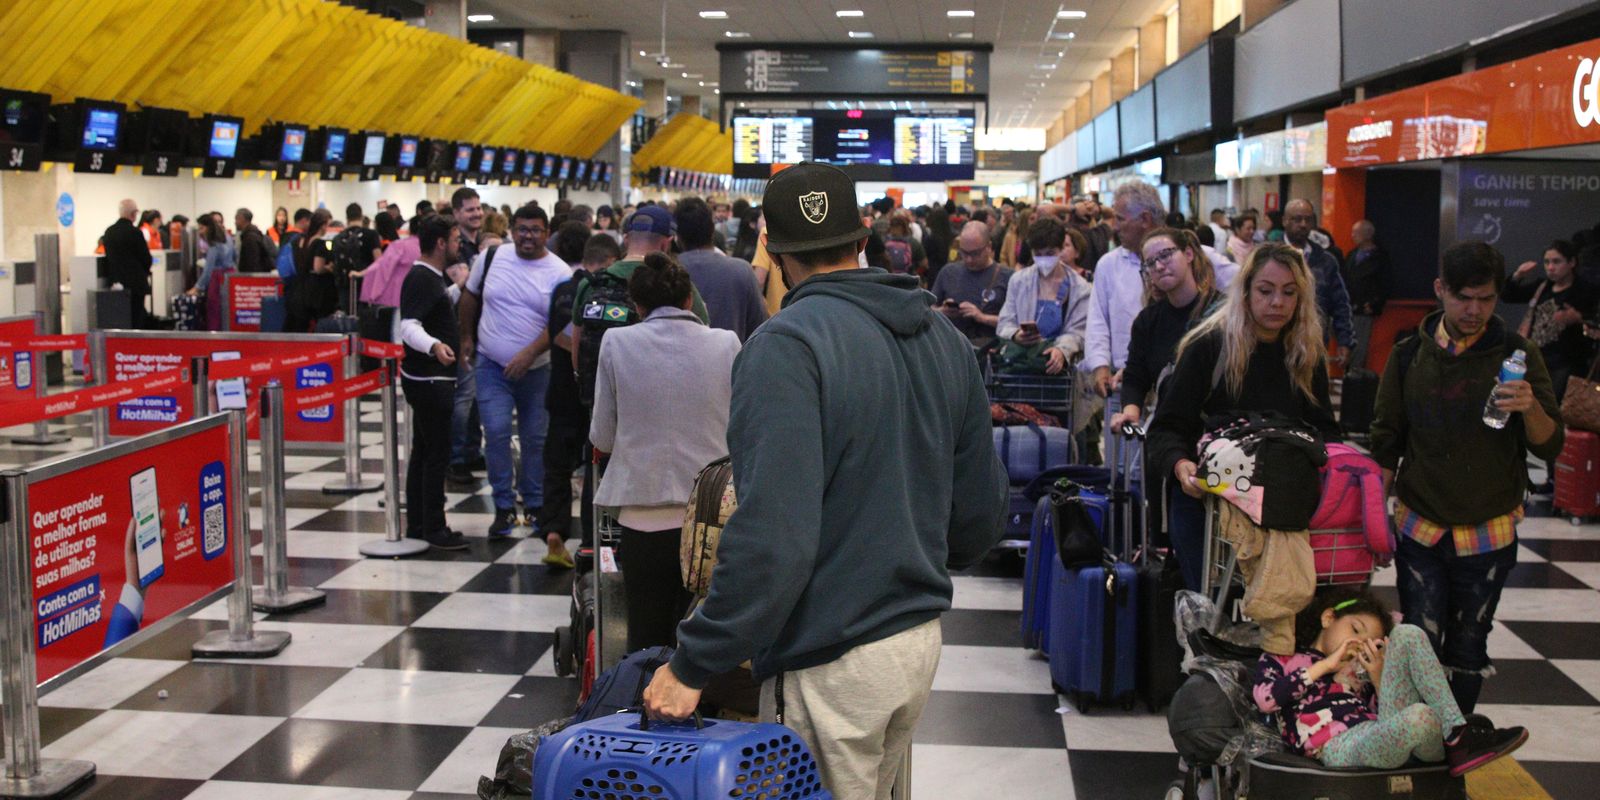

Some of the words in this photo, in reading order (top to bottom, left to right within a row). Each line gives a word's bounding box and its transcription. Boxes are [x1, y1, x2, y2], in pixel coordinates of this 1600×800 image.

[9, 147, 24, 167] 34
[90, 152, 103, 170] 35
[156, 157, 168, 174] 36
[215, 160, 226, 176] 37
[1474, 174, 1535, 191] GANHE
[1540, 175, 1600, 191] TEMPO
[1474, 198, 1500, 207] save
[1504, 197, 1530, 208] time
[115, 352, 138, 362] Quer
[140, 353, 182, 364] aprender
[123, 363, 156, 372] melhor
[303, 369, 327, 378] Baixe
[116, 372, 128, 381] de
[121, 408, 177, 421] HotMilhas
[204, 474, 221, 489] Baixe
[203, 493, 208, 502] o
[33, 509, 58, 529] Quer
[60, 493, 104, 521] aprender
[34, 535, 42, 548] a
[43, 522, 78, 546] melhor
[78, 511, 107, 533] forma
[35, 550, 48, 568] de
[50, 538, 84, 563] utilizar
[85, 534, 96, 548] as
[36, 569, 59, 588] suas
[60, 550, 96, 579] milhas?
[38, 595, 67, 617] Conte
[67, 586, 86, 604] com
[87, 582, 94, 595] a
[43, 603, 102, 645] HotMilhas
